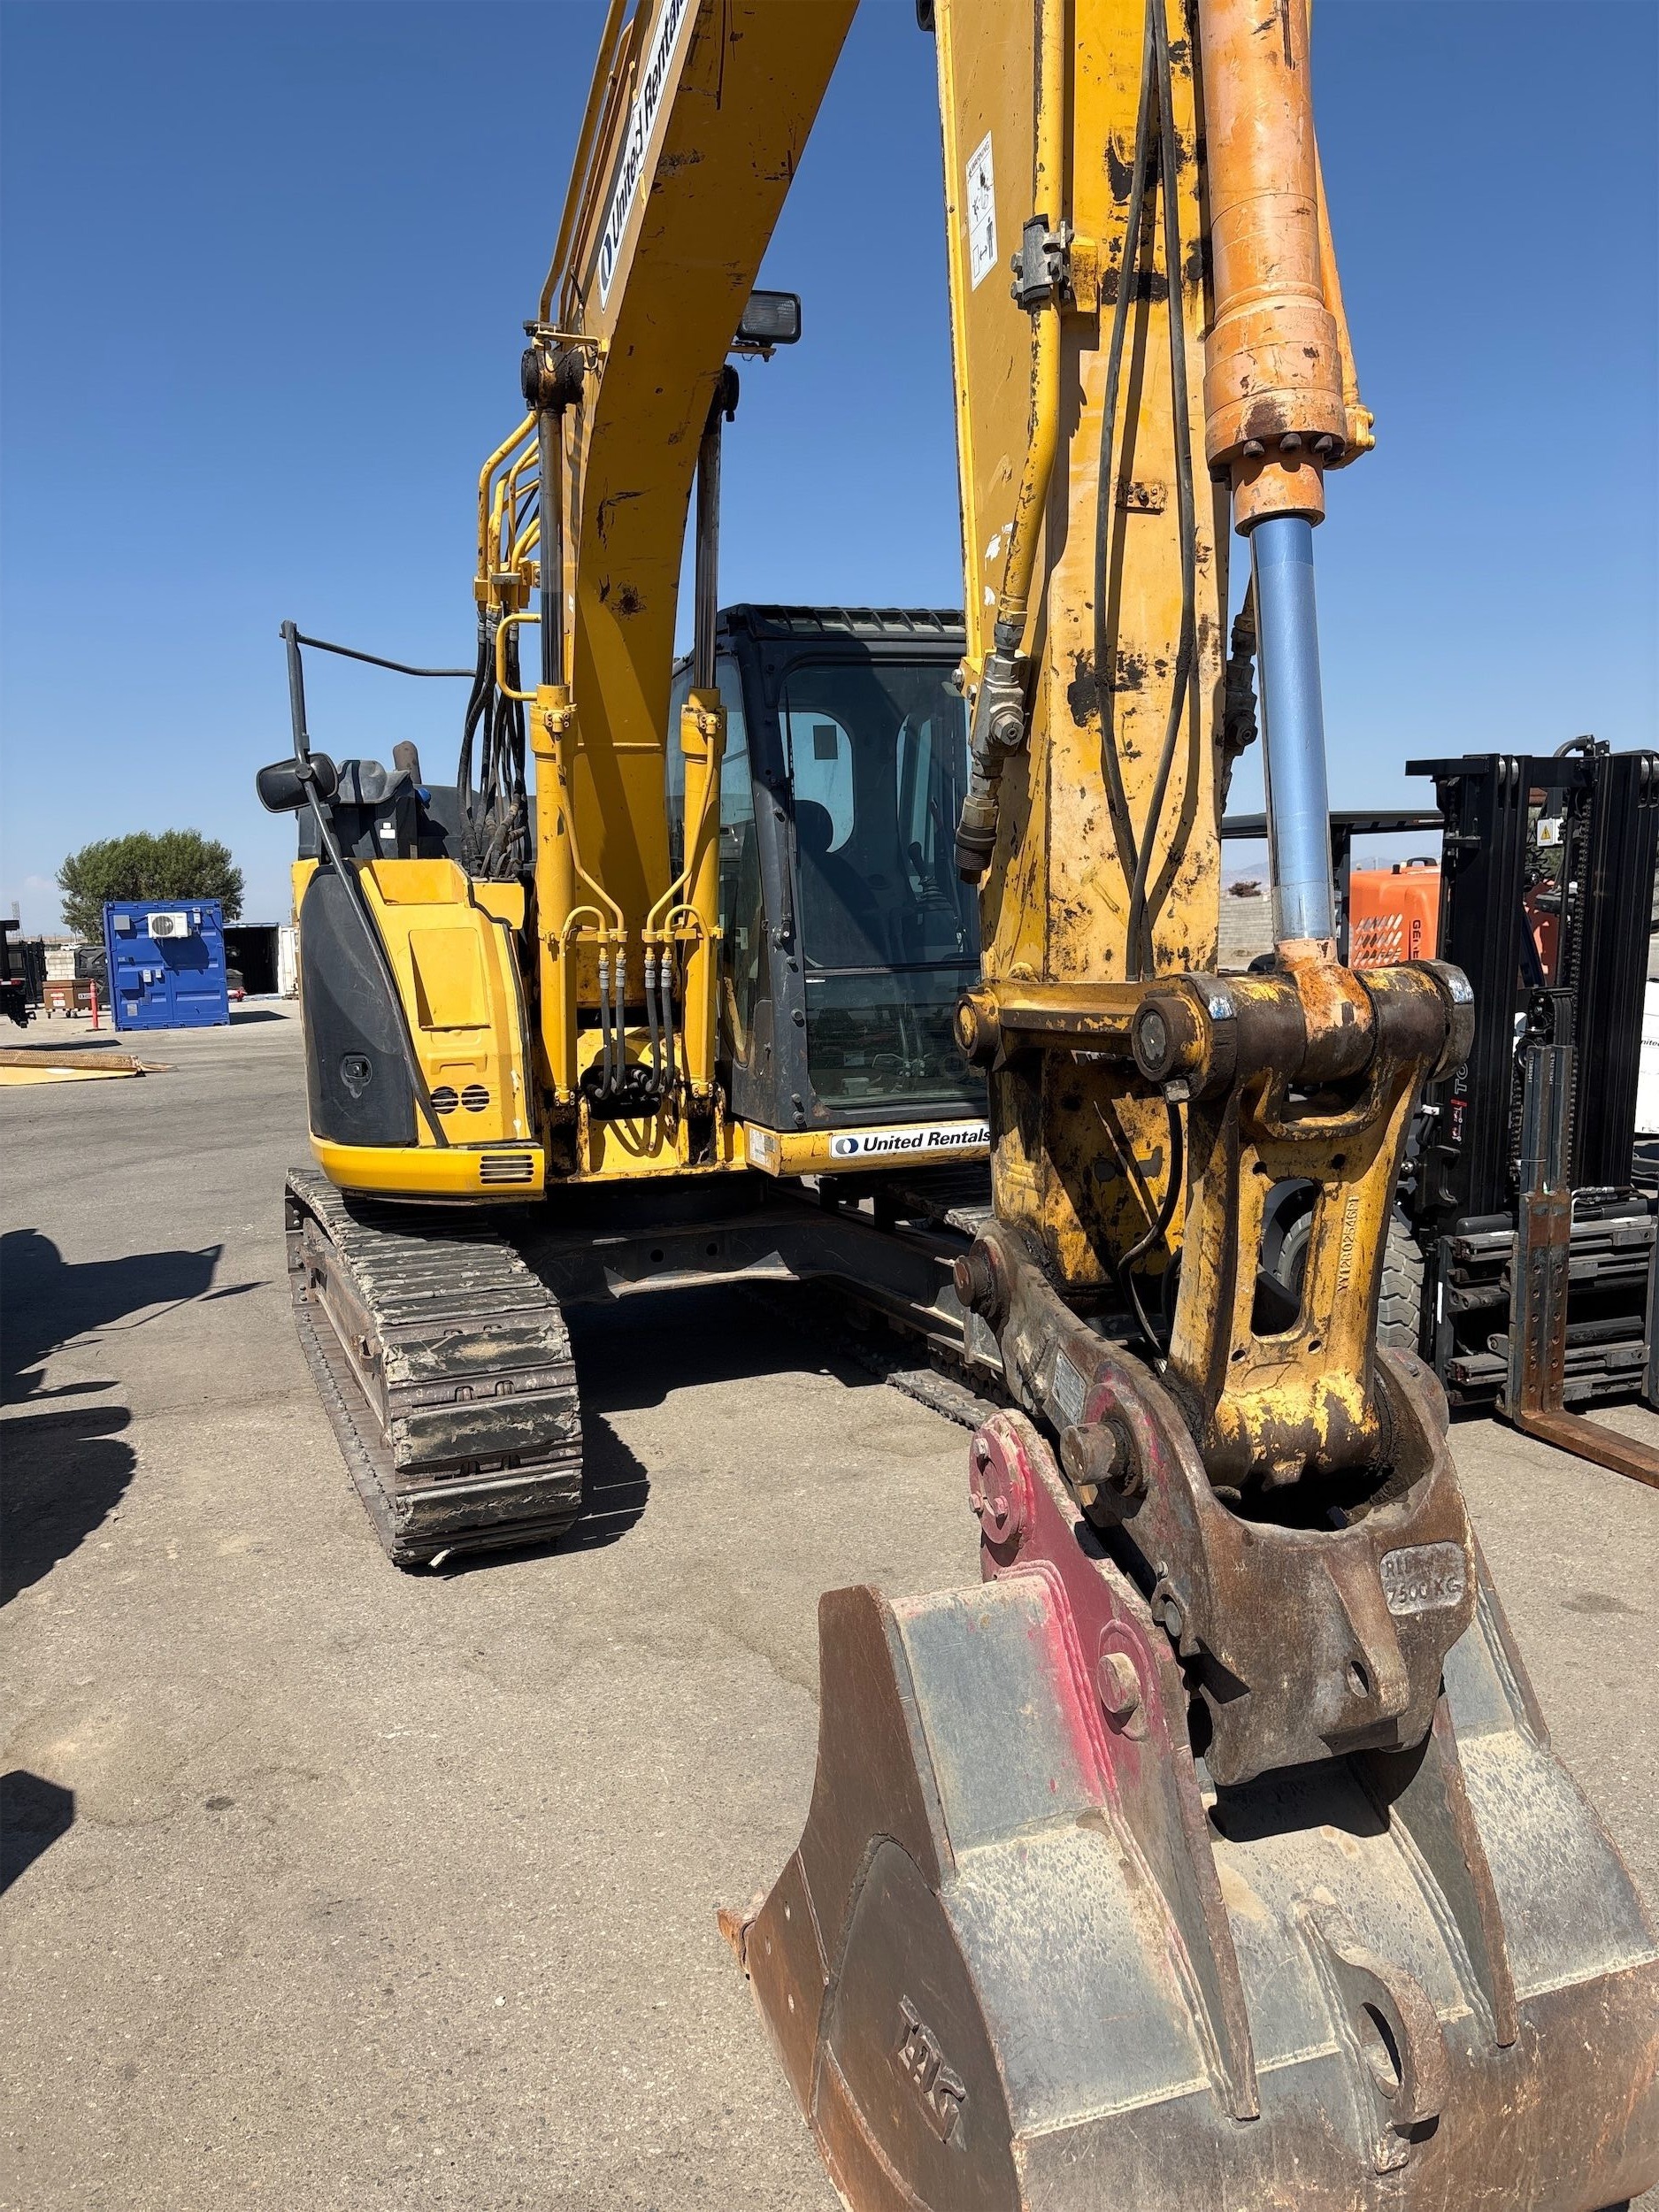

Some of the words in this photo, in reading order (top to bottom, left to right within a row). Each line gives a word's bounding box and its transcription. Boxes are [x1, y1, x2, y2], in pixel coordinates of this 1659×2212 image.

[612, 109, 643, 249] United
[864, 1133, 923, 1151] United
[927, 1128, 991, 1146] Rentals
[1433, 1576, 1460, 1596] KG
